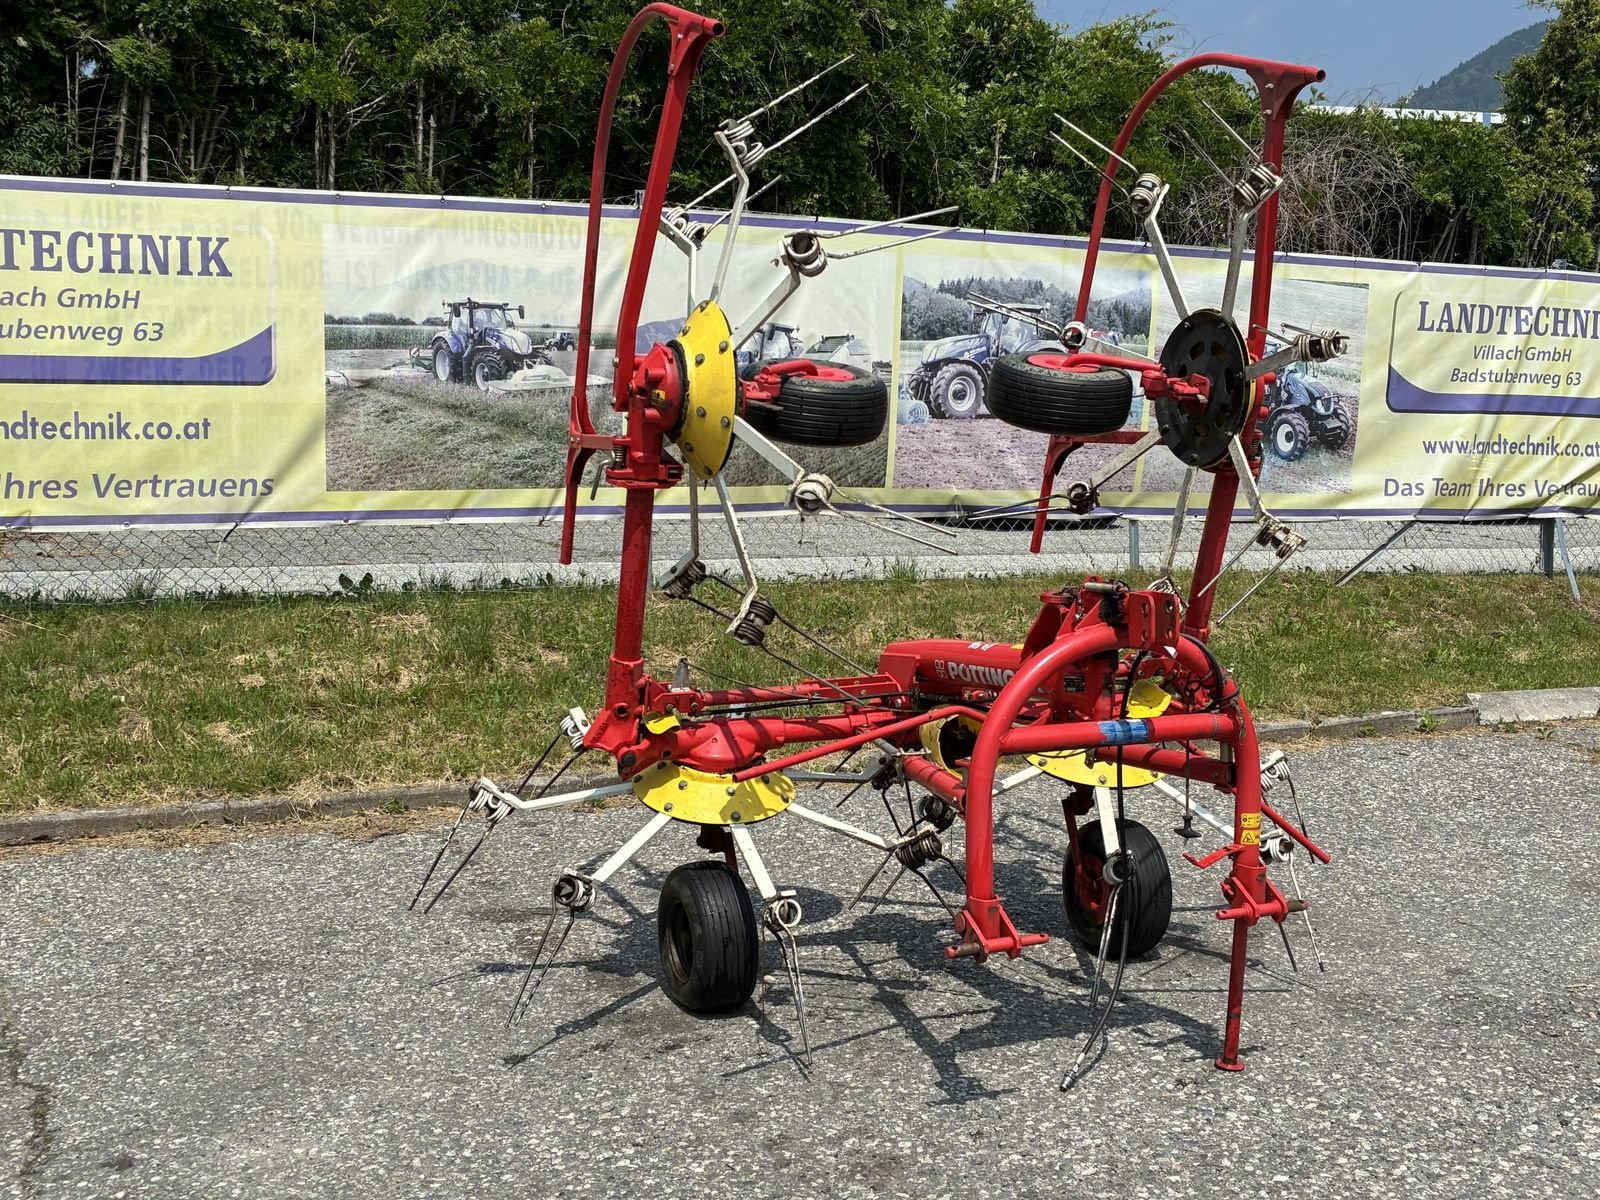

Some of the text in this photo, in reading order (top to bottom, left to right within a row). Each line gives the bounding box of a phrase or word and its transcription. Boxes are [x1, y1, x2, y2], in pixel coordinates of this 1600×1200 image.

[0, 228, 233, 277] TECHNIK
[0, 286, 141, 309] ach GmbH
[1417, 301, 1600, 339] LANDTECHNI
[133, 322, 164, 342] 63
[1473, 345, 1572, 362] Villach GmbH
[1450, 368, 1582, 388] Badstubenweg 63
[1422, 433, 1600, 457] www.landtechnik.co.at
[0, 472, 274, 499] hres Vertrauens
[1384, 477, 1600, 498] Das Team Ihres Vertrau
